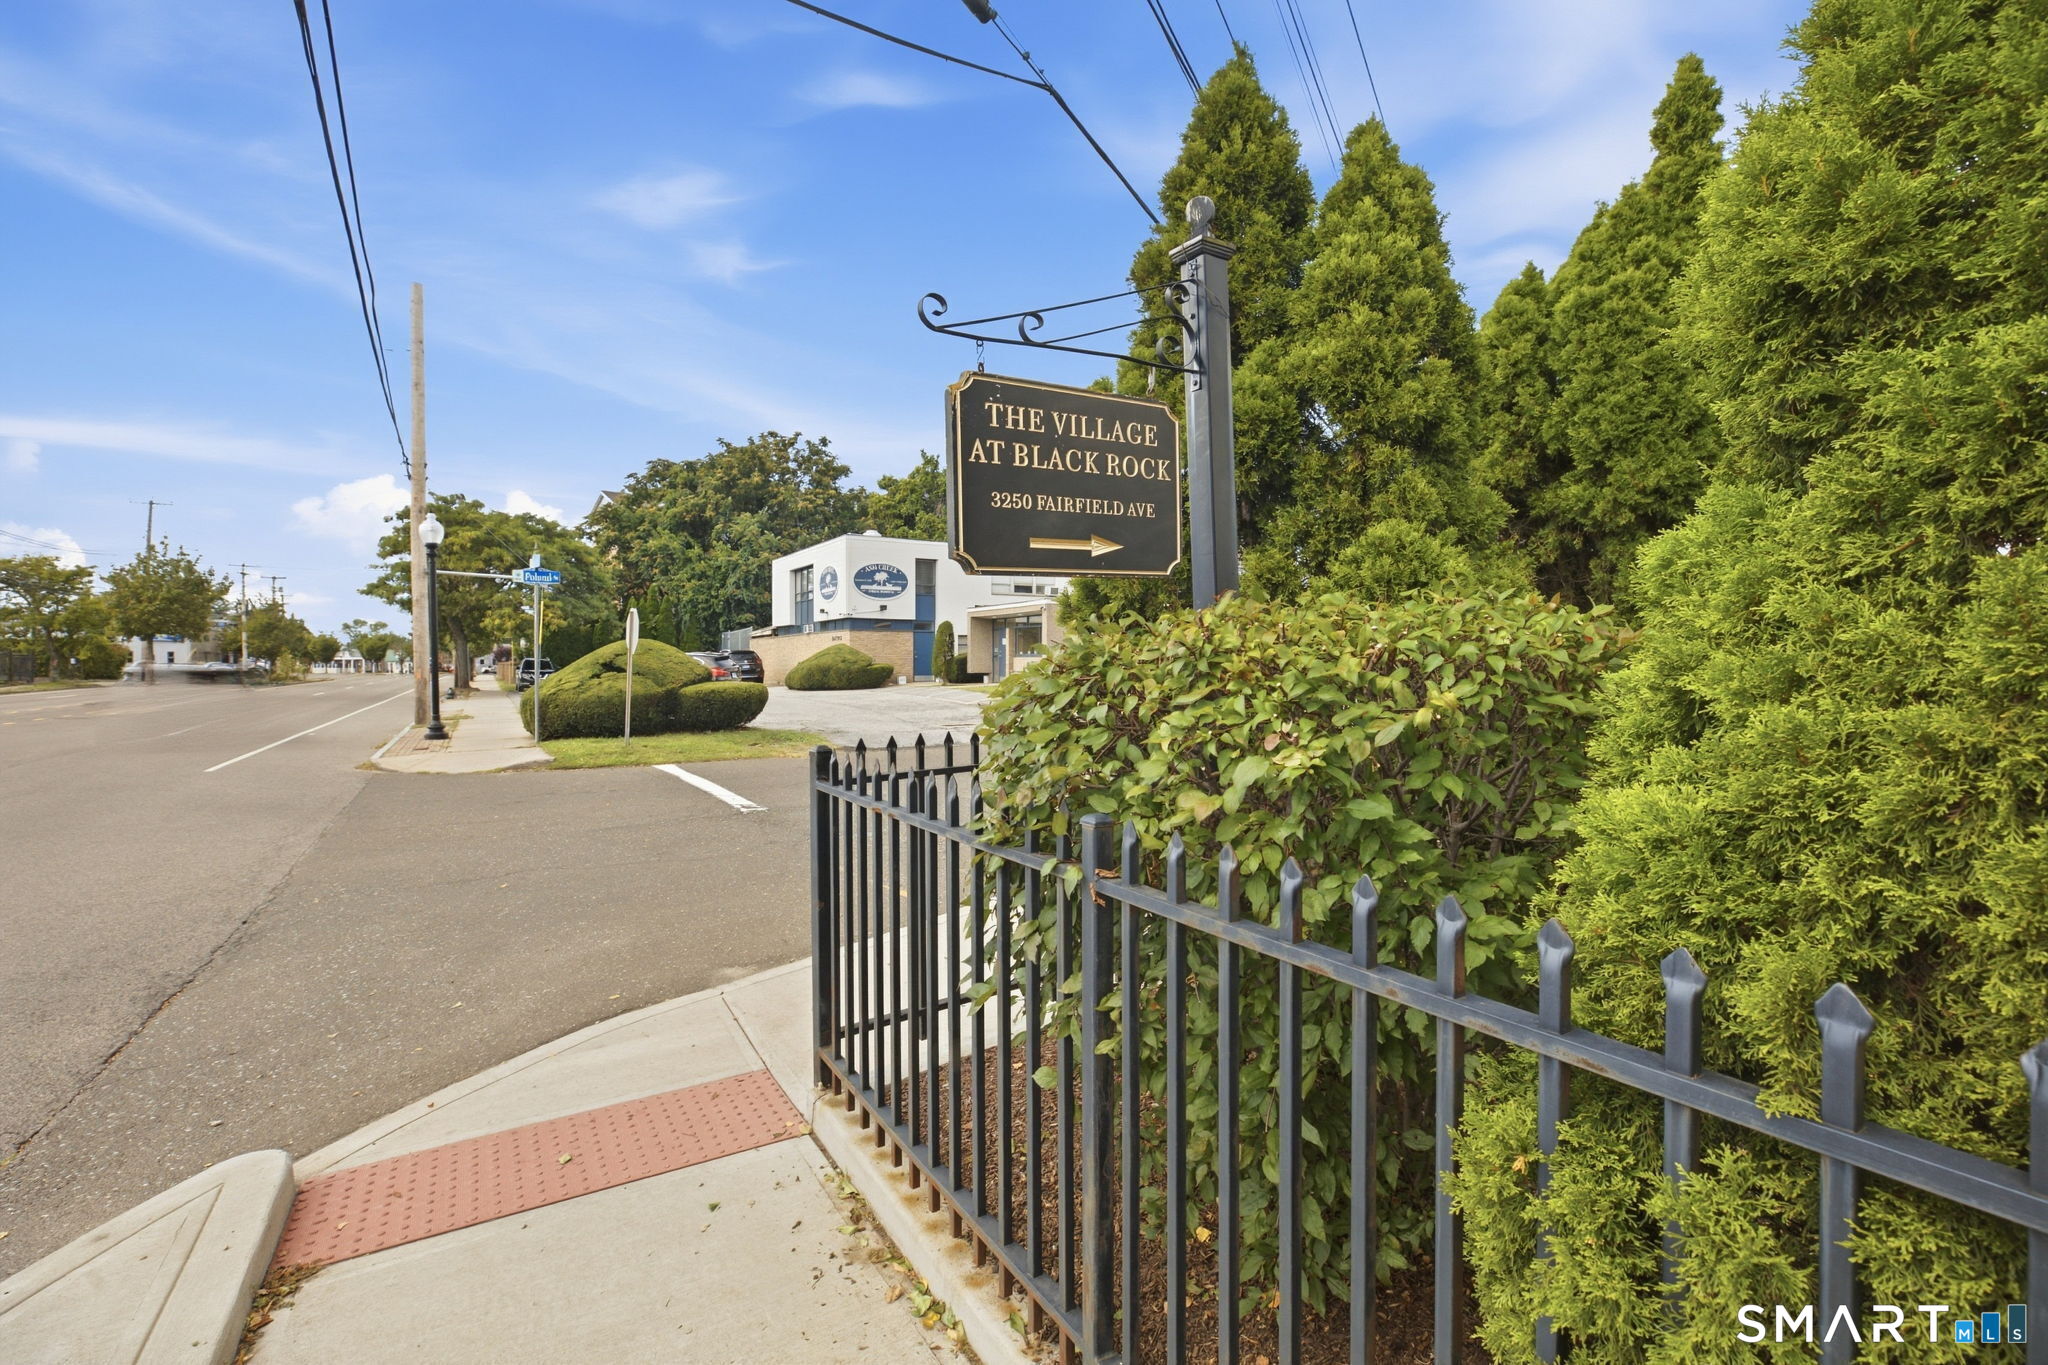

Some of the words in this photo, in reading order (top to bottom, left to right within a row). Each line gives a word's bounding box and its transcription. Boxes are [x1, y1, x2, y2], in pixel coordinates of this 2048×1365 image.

[984, 401, 1045, 433] THE
[1050, 410, 1158, 447] VILLAGE
[968, 437, 1005, 465] AT
[1012, 442, 1100, 475] BLACK
[1105, 452, 1171, 481] ROCK
[991, 491, 1033, 510] 3250
[1036, 494, 1124, 516] FAIRFIELD
[1127, 501, 1156, 518] AVE
